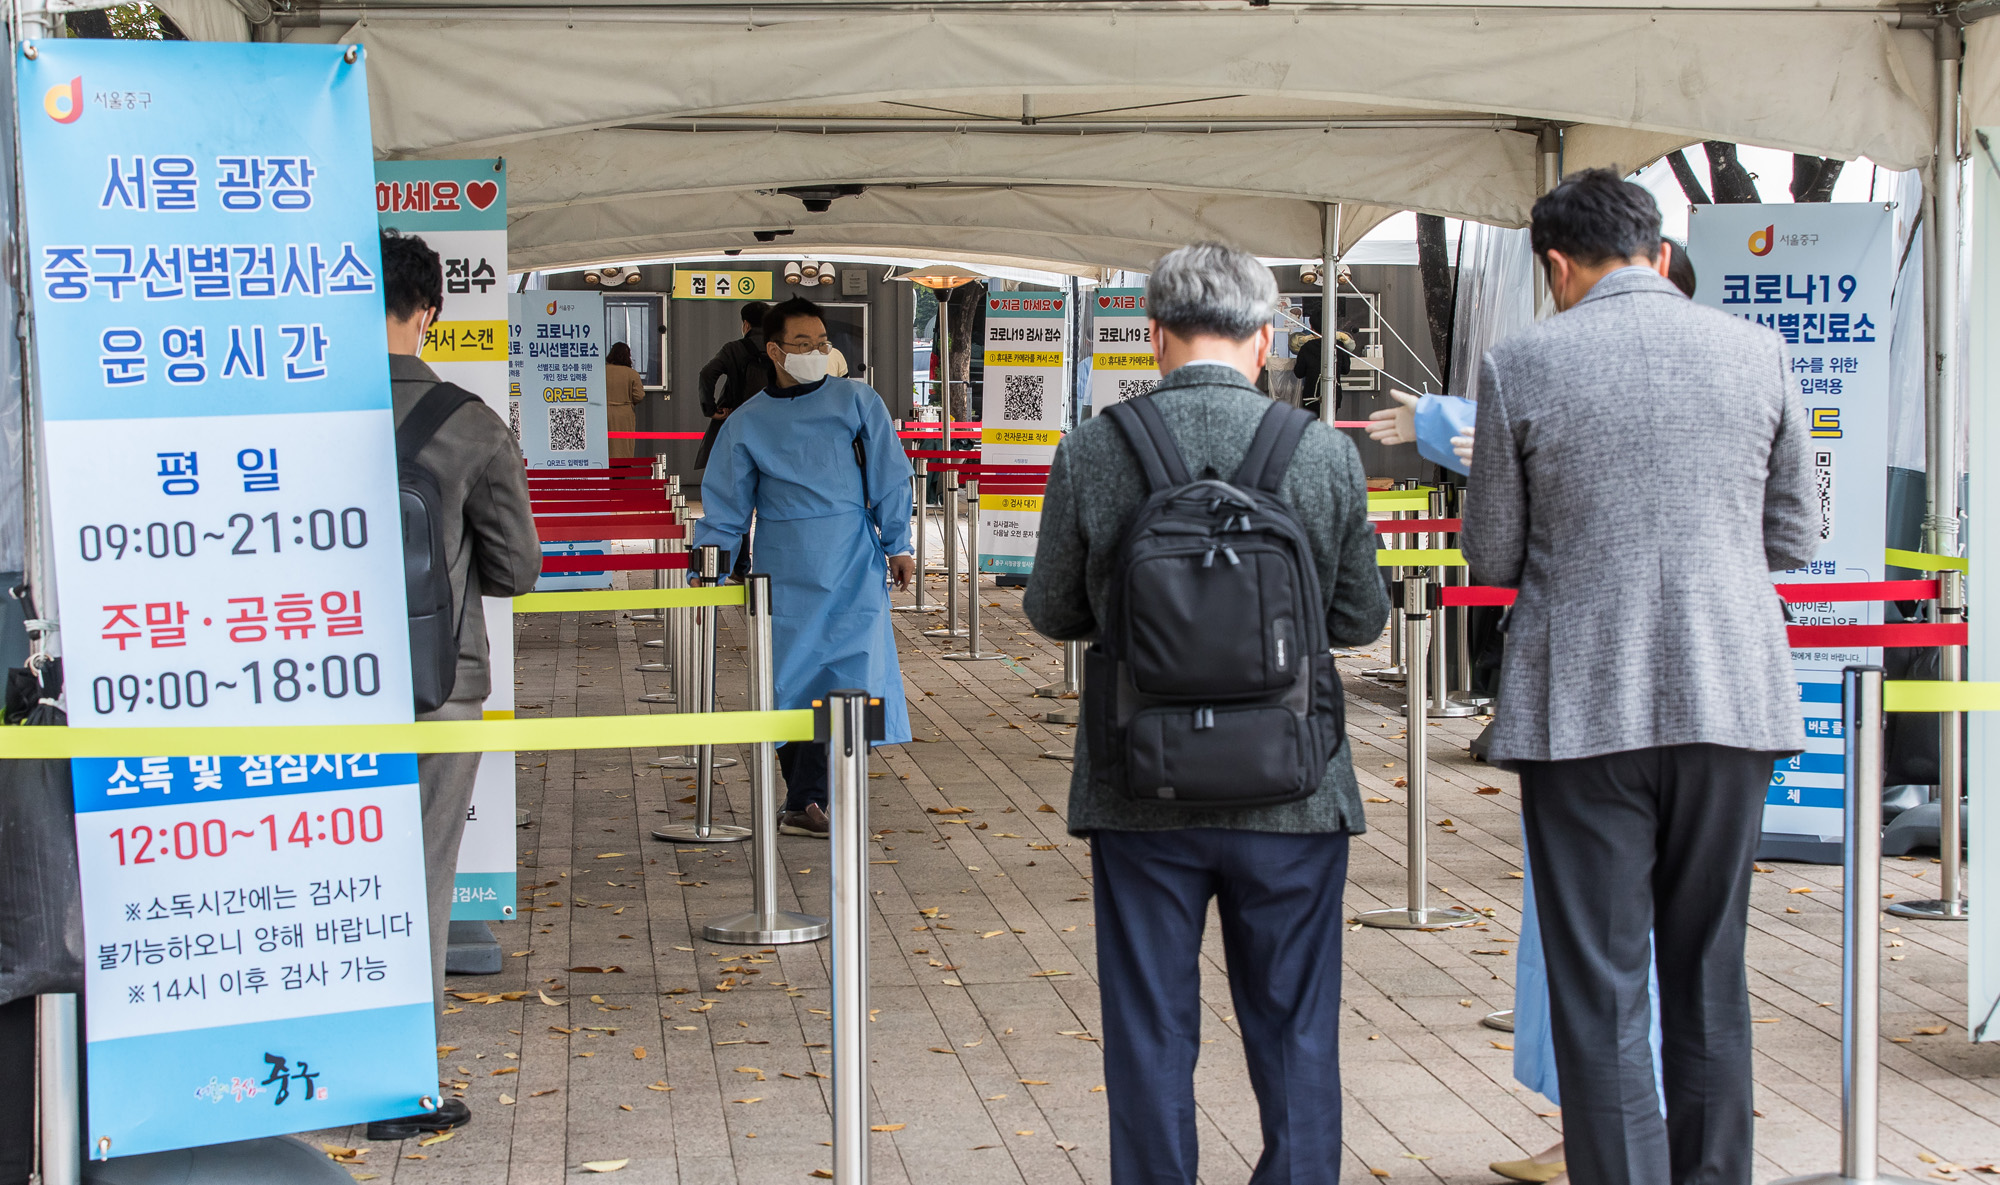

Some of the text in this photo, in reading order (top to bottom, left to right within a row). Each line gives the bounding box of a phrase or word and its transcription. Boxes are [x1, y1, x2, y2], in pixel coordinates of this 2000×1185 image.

[94, 90, 152, 111] 서울중구
[100, 156, 316, 212] 서울 광장
[375, 180, 461, 213] 하세요
[1779, 233, 1819, 246] 서울중구
[43, 244, 375, 301] 중구선별검사소
[445, 257, 496, 294] 접수
[1722, 274, 1857, 305] 코로나19
[1001, 299, 1051, 311] 지금 하세요
[1112, 296, 1136, 309] 지금
[460, 327, 494, 351] 스캔
[536, 323, 591, 339] 코로나19
[989, 327, 1061, 342] 코로나19 검사 접수
[1098, 327, 1141, 343] 코로나19
[529, 341, 600, 358] 임시선별진료소
[997, 353, 1013, 363] 휴대폰
[1013, 353, 1035, 363] 카메라를
[1036, 353, 1047, 363] 켜서
[1048, 354, 1060, 364] 스캔
[1108, 355, 1128, 366] 휴대폰
[1791, 357, 1858, 374] 수를 위한
[536, 363, 593, 372] 선별진료 접수를 위한
[543, 373, 587, 382] 개인 정보 입력용
[543, 387, 588, 403] QR코드
[1800, 378, 1843, 395] 입력용
[1004, 432, 1034, 442] 전자문진표
[1035, 433, 1048, 443] 작성
[547, 459, 589, 467] QR코드 입력방법
[1010, 498, 1023, 508] 검사
[1024, 499, 1037, 509] 대기
[79, 507, 369, 562] 09:00~21:00
[92, 653, 381, 715] 09:00~18:00
[1808, 720, 1830, 735] 버튼
[105, 757, 174, 796] 소독
[188, 756, 224, 792] 및
[109, 805, 384, 867] 12:00~14:00
[309, 875, 382, 906] 검사가
[97, 912, 413, 971] 불가능하오니 양해 바랍니다
[219, 966, 269, 996] 이후
[281, 960, 329, 991] 검사
[340, 955, 388, 983] 가능
[261, 1052, 320, 1106] 중구
